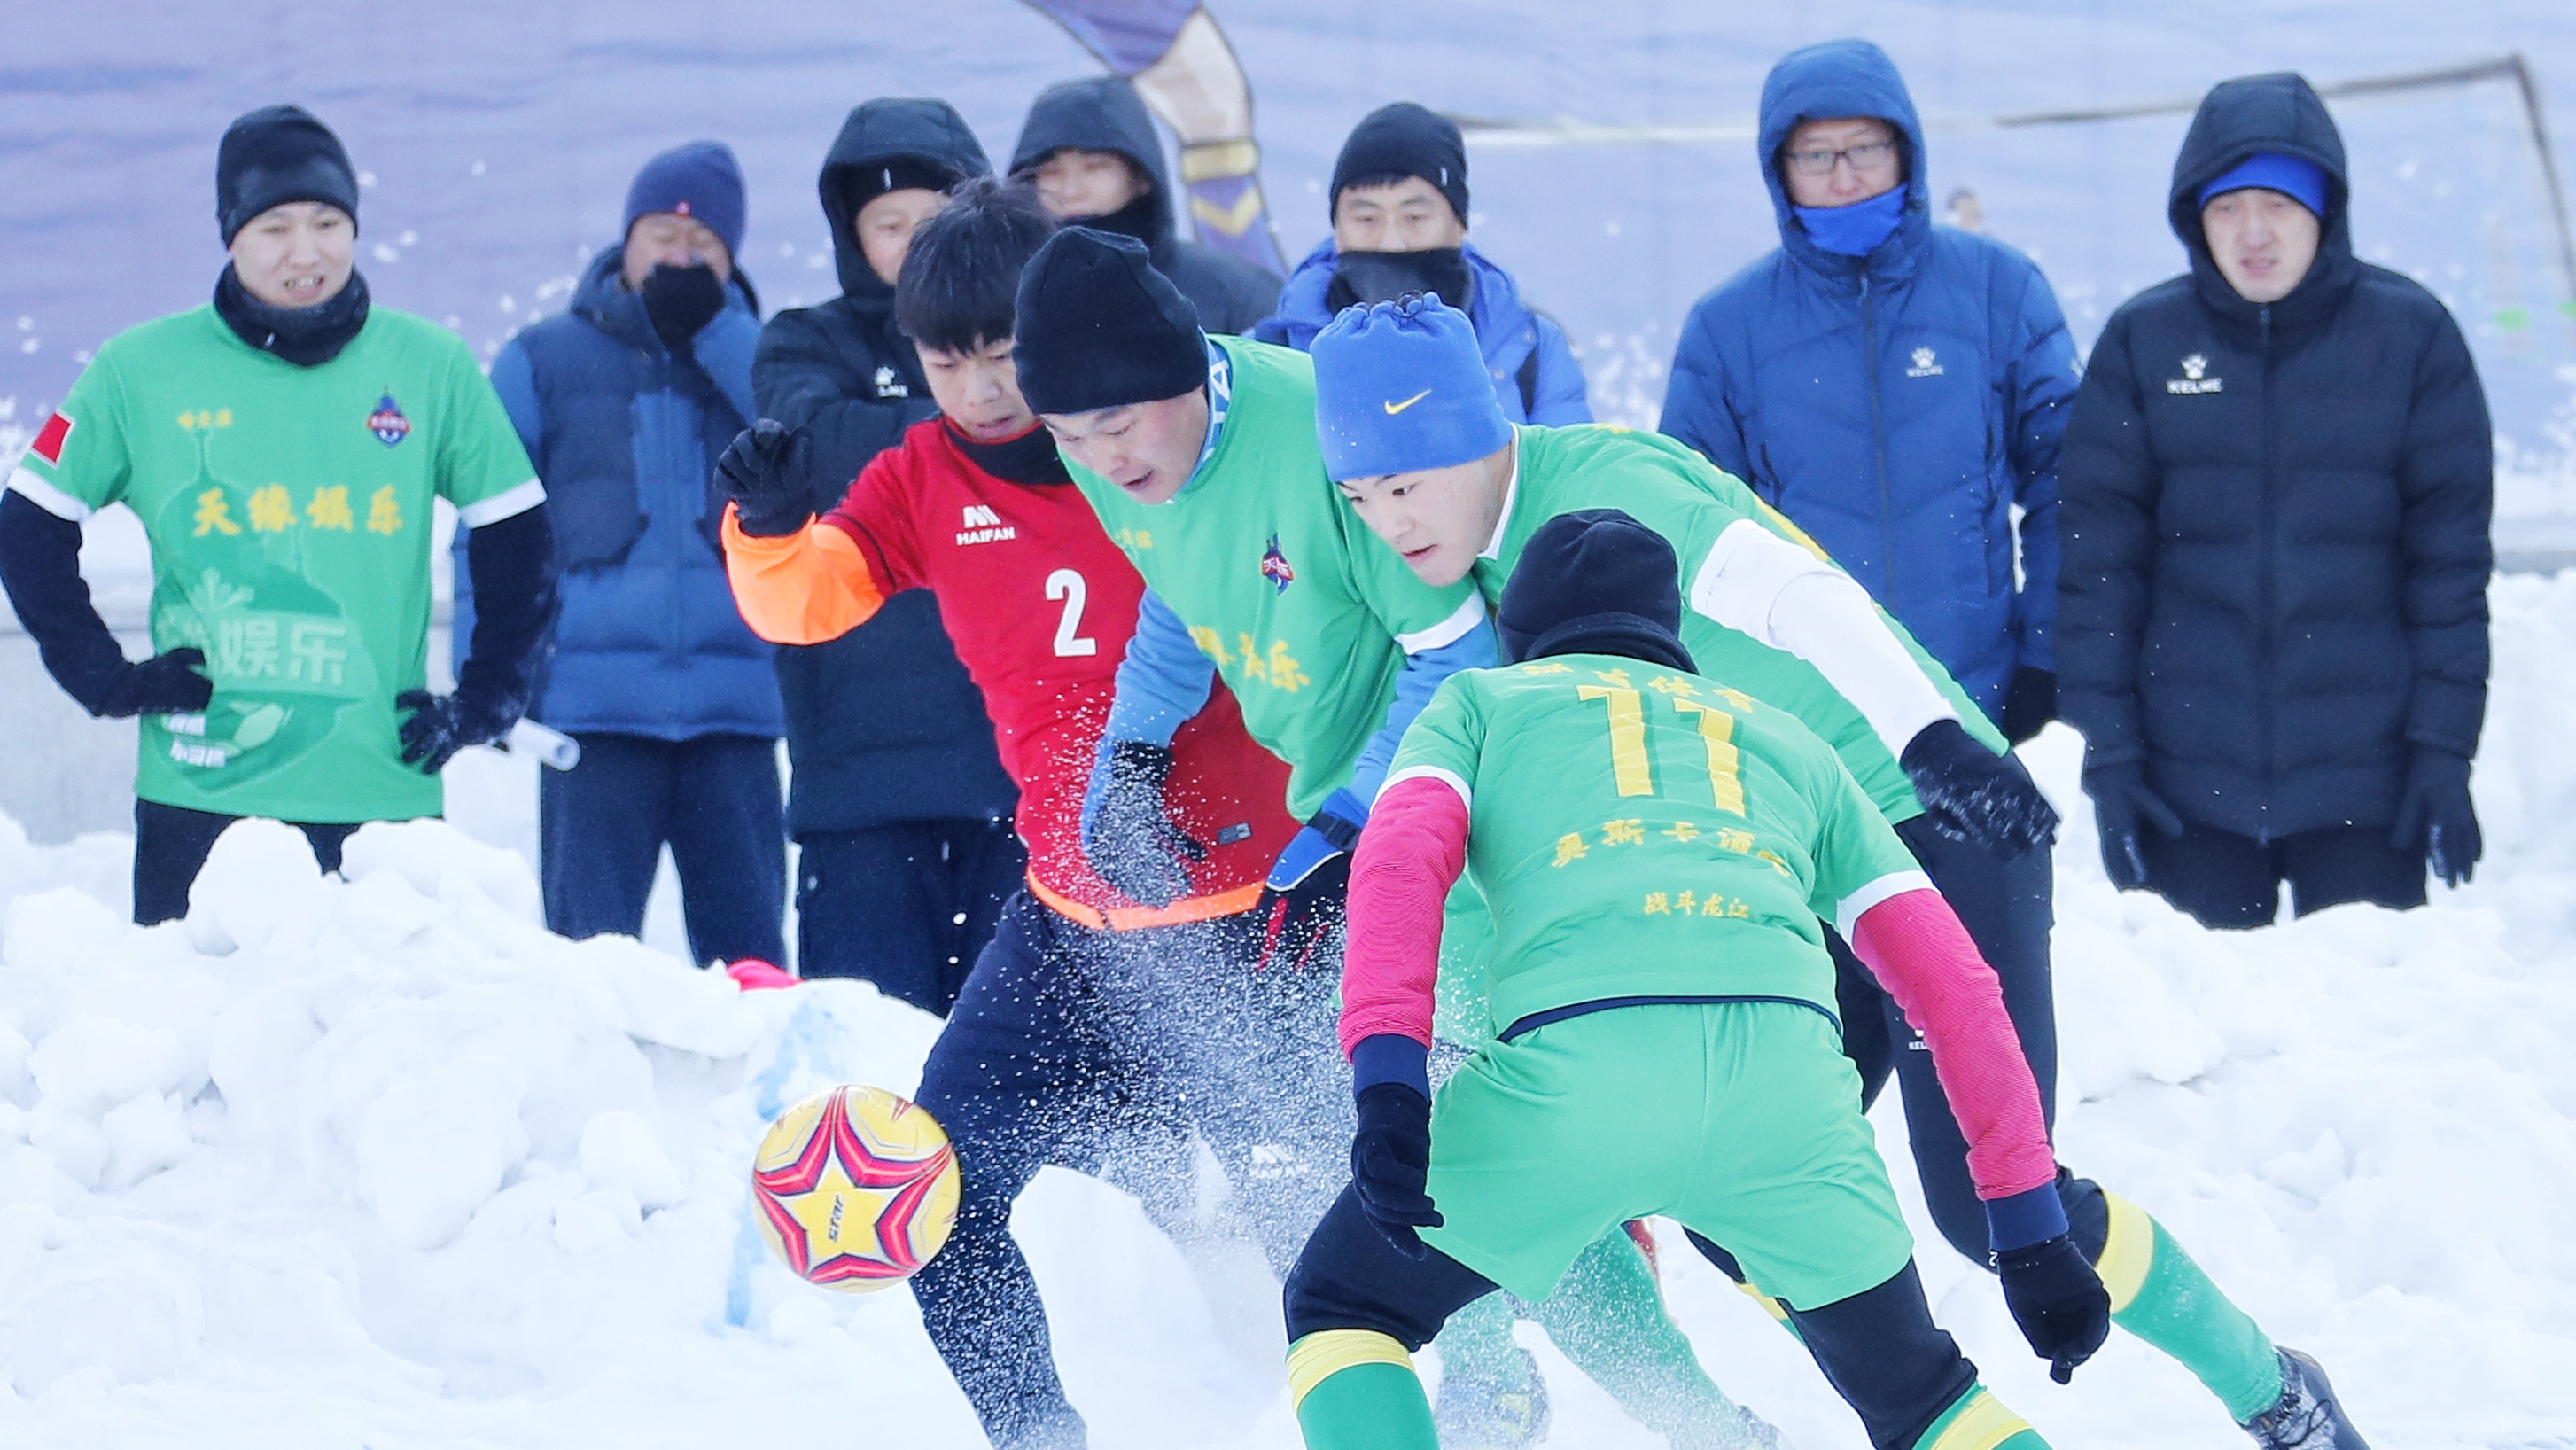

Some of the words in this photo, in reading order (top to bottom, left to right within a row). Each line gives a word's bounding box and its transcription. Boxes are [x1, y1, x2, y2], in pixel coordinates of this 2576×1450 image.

[2167, 378, 2222, 394] KELME
[955, 526, 1016, 546] HAIFAN
[1045, 568, 1097, 657] 2
[1576, 685, 1746, 816] 11
